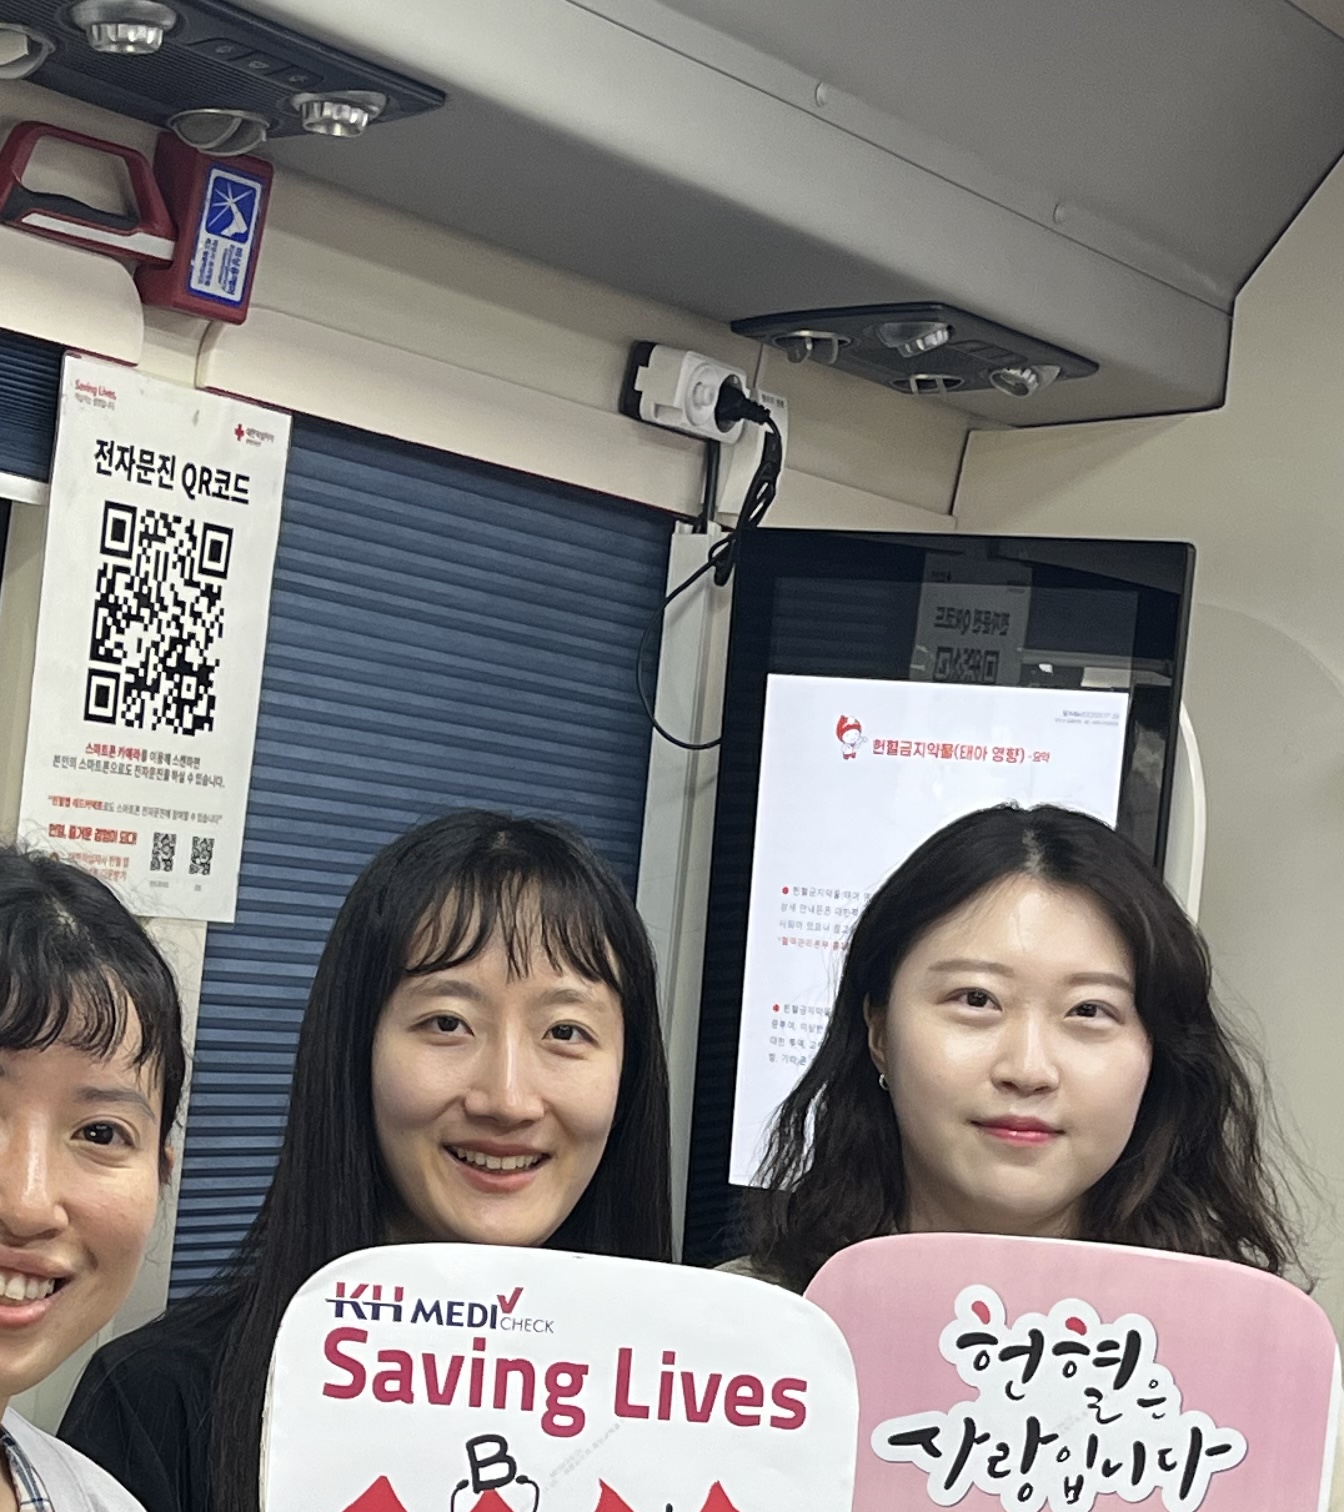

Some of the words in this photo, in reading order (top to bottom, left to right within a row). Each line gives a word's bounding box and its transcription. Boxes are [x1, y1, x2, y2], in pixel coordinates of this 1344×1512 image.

[94, 438, 176, 490] 전자문진
[181, 462, 250, 505] QR코드
[322, 1326, 589, 1438] Saving
[614, 1347, 809, 1431] Lives
[466, 1433, 518, 1494] B
[887, 1416, 1233, 1504] 사랑입니다
